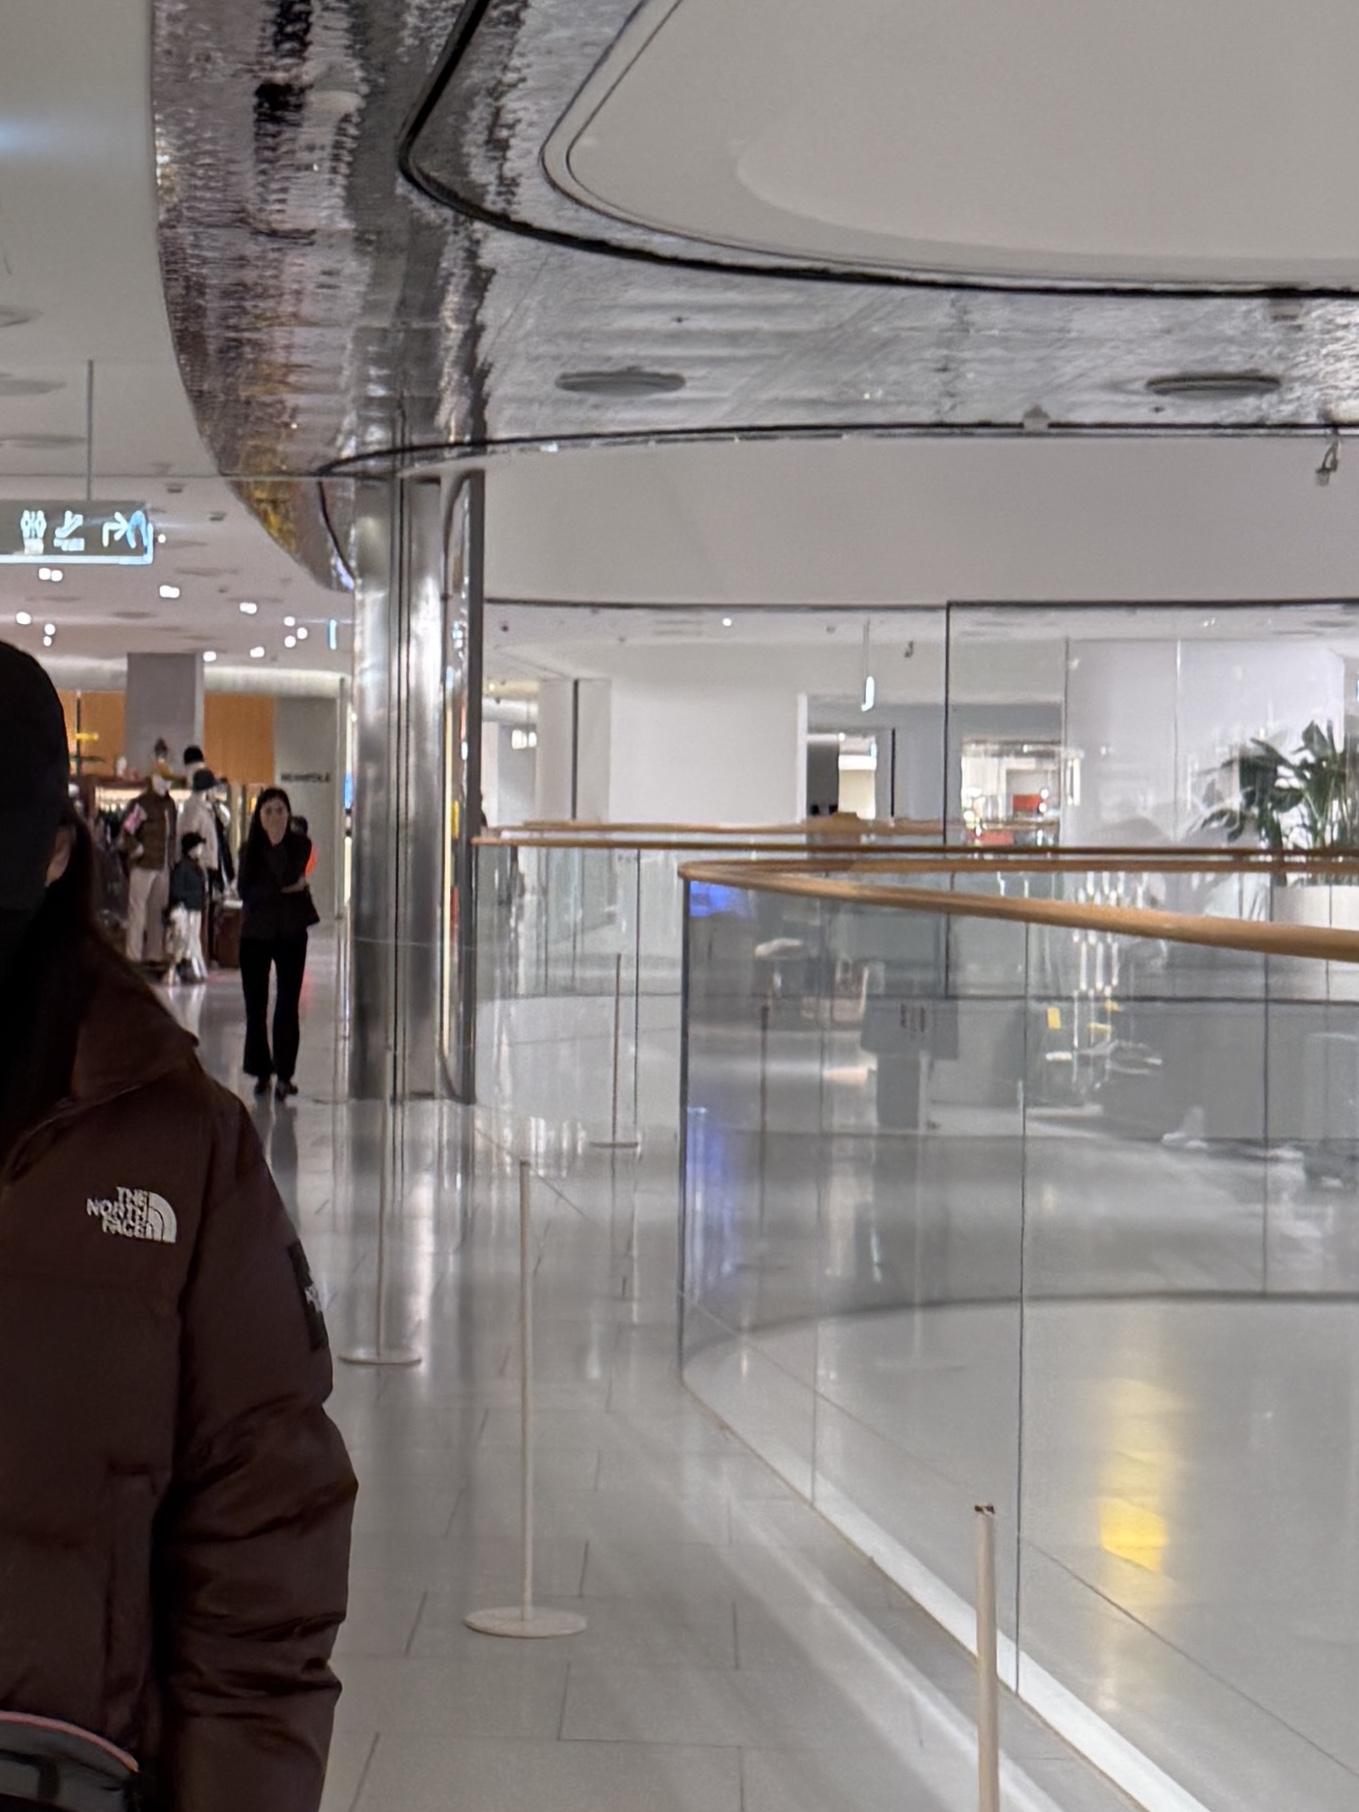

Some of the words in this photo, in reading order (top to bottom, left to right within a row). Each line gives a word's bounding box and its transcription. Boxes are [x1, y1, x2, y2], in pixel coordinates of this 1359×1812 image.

[117, 1187, 147, 1206] THE
[87, 1198, 148, 1224] NORTH
[102, 1217, 147, 1239] FACE
